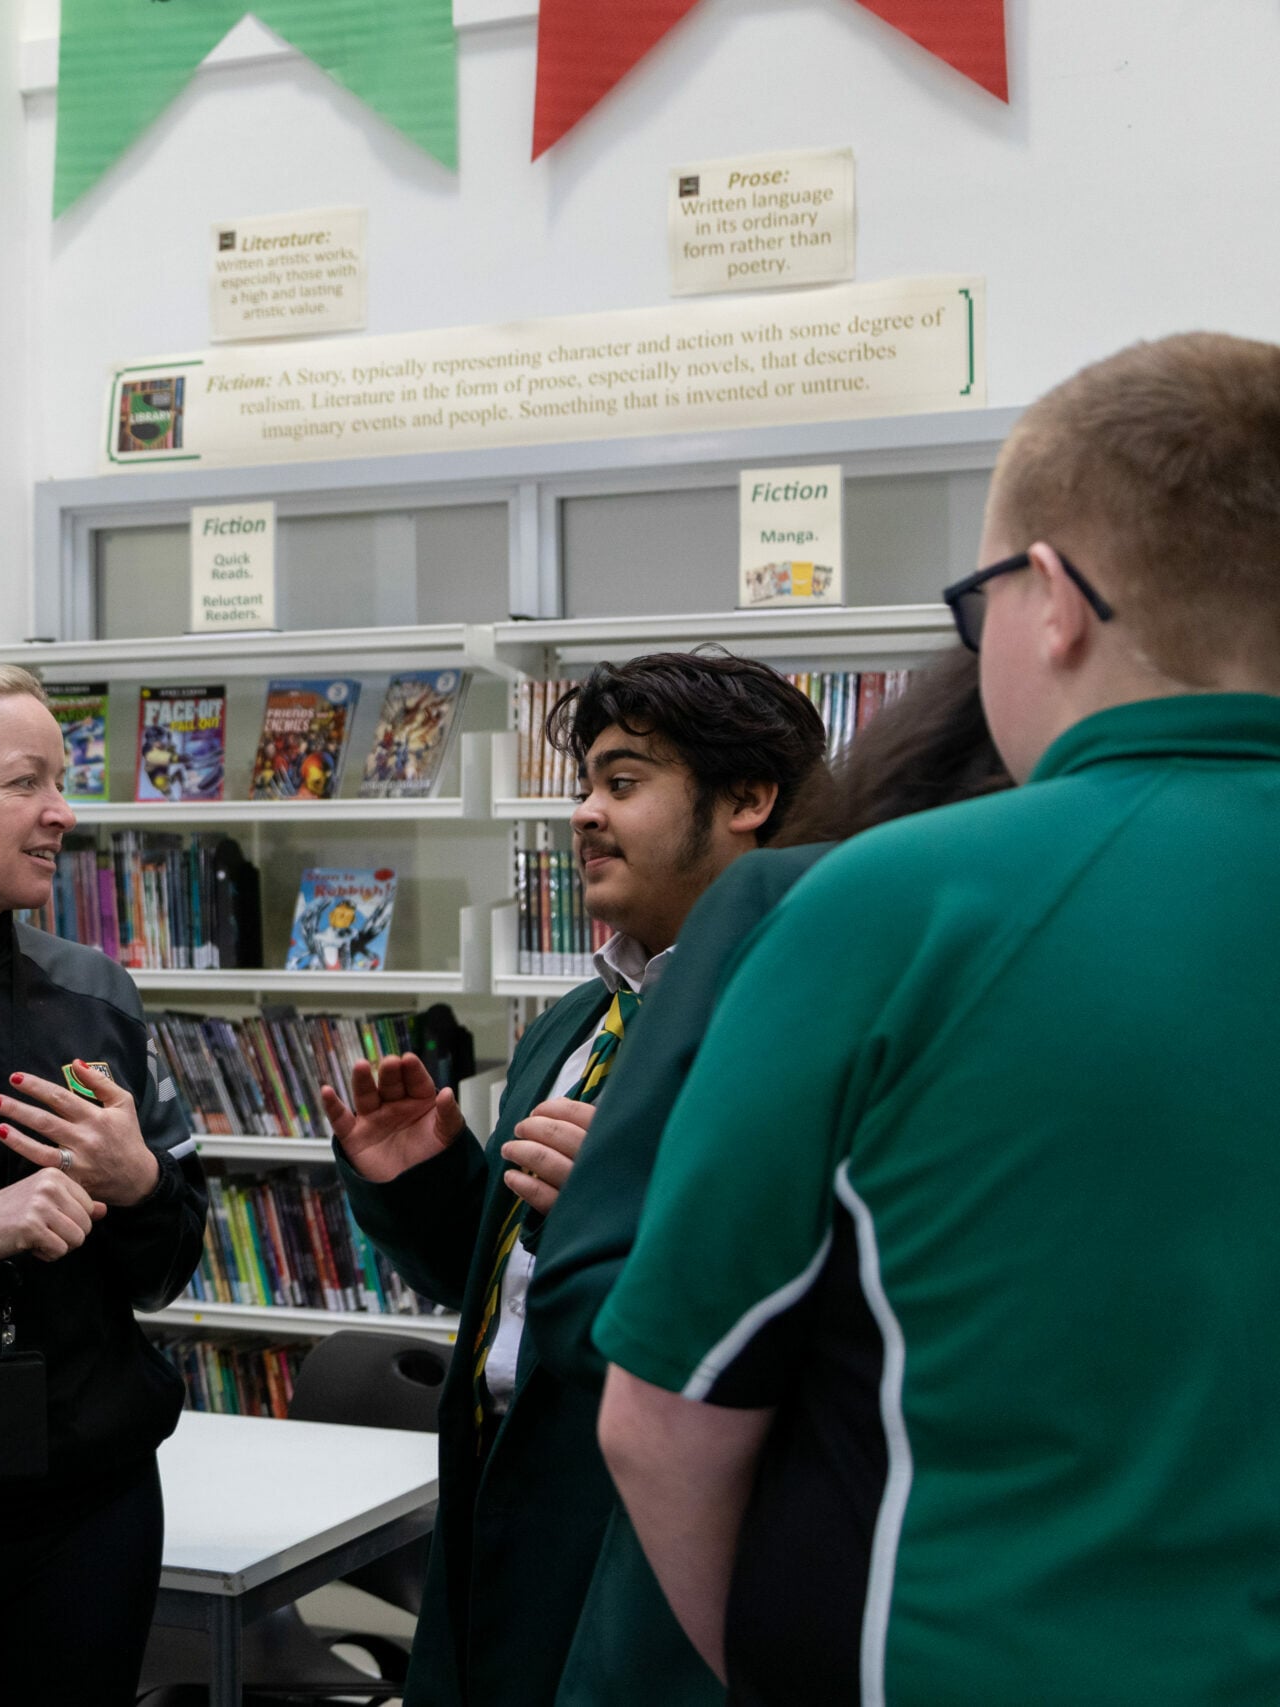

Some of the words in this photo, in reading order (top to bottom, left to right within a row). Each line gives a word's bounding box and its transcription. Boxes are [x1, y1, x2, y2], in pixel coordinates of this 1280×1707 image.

[728, 169, 791, 189] Prose:
[681, 199, 747, 216] Written
[751, 187, 834, 209] language
[695, 219, 711, 236] in
[716, 217, 737, 234] its
[742, 211, 818, 231] ordinary
[241, 231, 332, 252] Literature:
[683, 241, 724, 259] form
[729, 235, 785, 254] rather
[789, 230, 832, 247] than
[216, 257, 263, 273] Written
[267, 252, 310, 267] artistic
[727, 257, 791, 280] poetry.
[221, 270, 281, 290] especially
[286, 267, 323, 283] those
[327, 264, 357, 278] with
[231, 294, 237, 304] a
[241, 288, 268, 304] high
[271, 286, 296, 300] and
[300, 283, 343, 298] lasting
[242, 305, 286, 320] artistic
[289, 301, 328, 316] value.
[207, 374, 273, 394] Fiction:
[278, 370, 294, 386] A
[298, 367, 347, 388] Story,
[352, 360, 426, 383] typically
[432, 350, 541, 378] representing
[548, 343, 630, 363] character
[637, 336, 670, 354] and
[676, 331, 734, 350] action
[740, 324, 783, 344] with
[789, 323, 841, 341] some
[847, 313, 914, 338] degree
[920, 308, 946, 328] of
[240, 396, 304, 416] realism.
[311, 389, 397, 409] Literature
[401, 387, 417, 403] in
[422, 382, 451, 402] the
[456, 379, 499, 399] form
[504, 375, 524, 395] of
[528, 371, 581, 398] prose,
[588, 361, 680, 387] especially
[687, 356, 756, 378] novels,
[761, 352, 797, 371] that
[804, 343, 897, 366] describes
[261, 420, 346, 442] imaginary
[351, 414, 406, 435] events
[412, 410, 444, 429] and
[449, 405, 512, 428] people.
[519, 394, 618, 420] Something
[623, 390, 659, 411] that
[664, 388, 681, 406] is
[685, 379, 769, 404] invented
[774, 382, 795, 397] or
[801, 376, 870, 395] untrue.
[751, 481, 828, 503] Fiction
[202, 516, 266, 537] Fiction
[760, 529, 819, 545] Manga.
[213, 552, 250, 567] Quick
[211, 567, 253, 580] Reads.
[202, 593, 263, 607] Reluctant
[205, 608, 261, 621] Readers.
[145, 699, 222, 727] FACE-OFF
